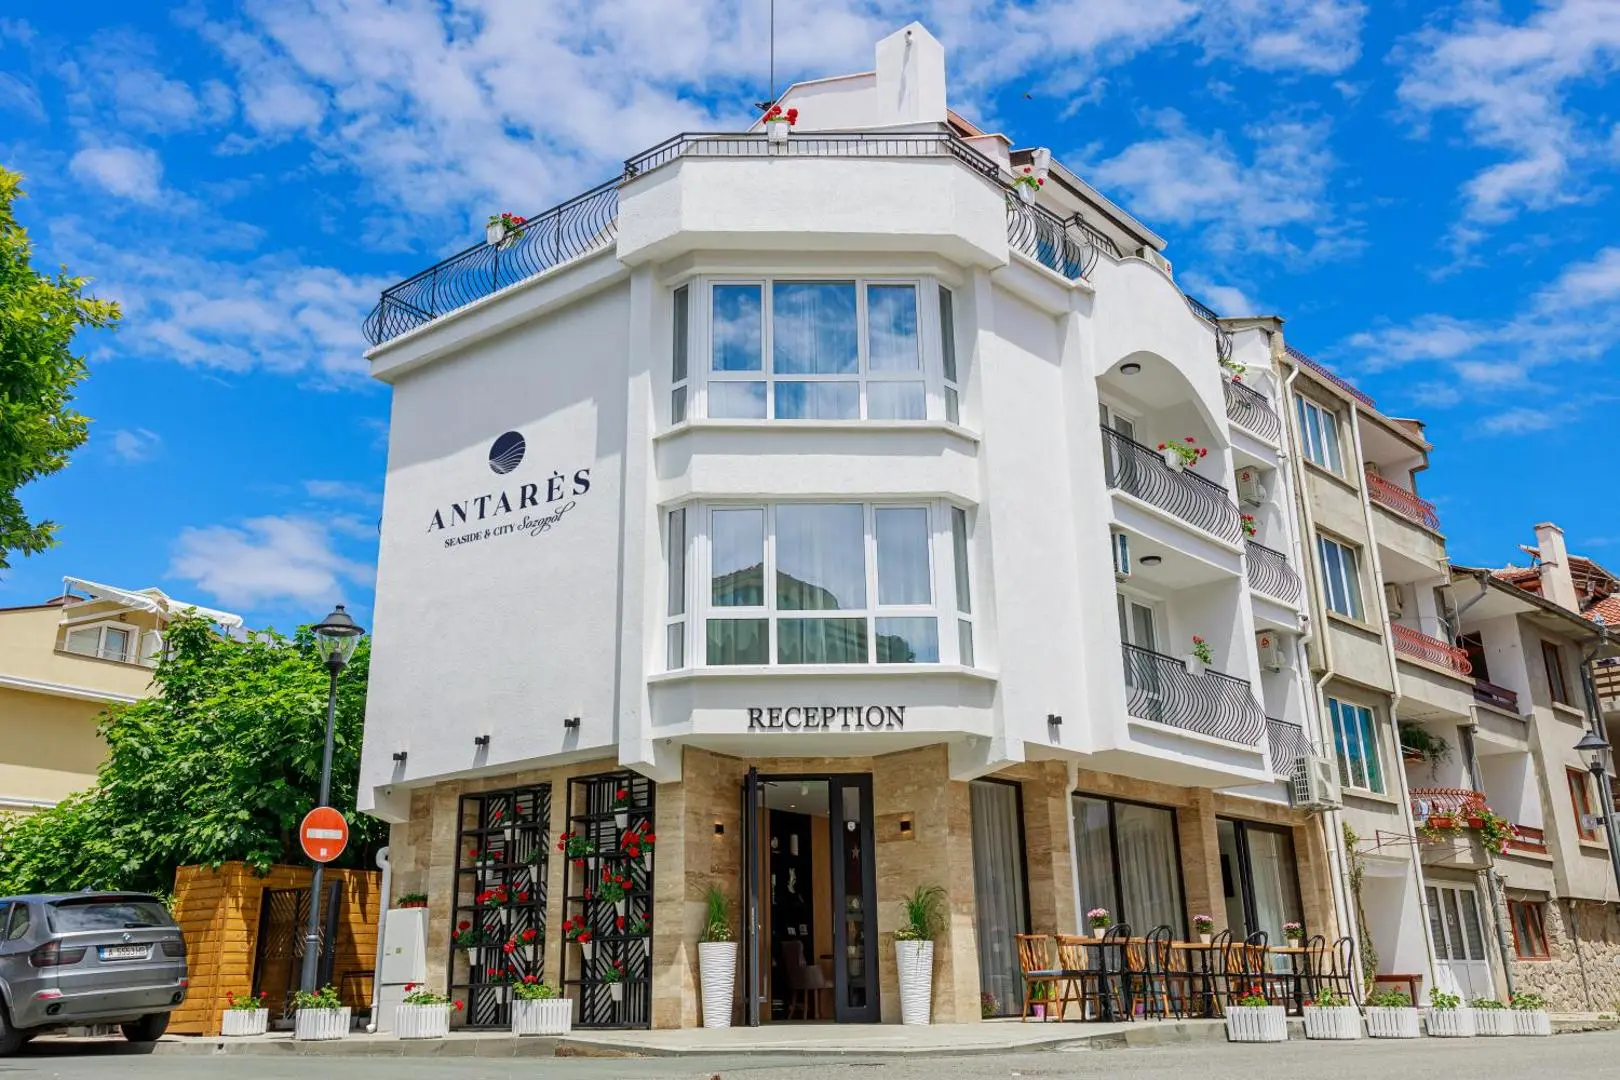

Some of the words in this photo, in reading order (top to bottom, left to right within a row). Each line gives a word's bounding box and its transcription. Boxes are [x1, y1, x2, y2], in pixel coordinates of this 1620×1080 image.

[427, 468, 591, 533] ANTARÈS
[444, 531, 483, 548] SEASIDE
[484, 529, 491, 539] &
[493, 523, 516, 537] CITY
[517, 501, 576, 537] Sozopol
[747, 705, 906, 729] RECEPTION
